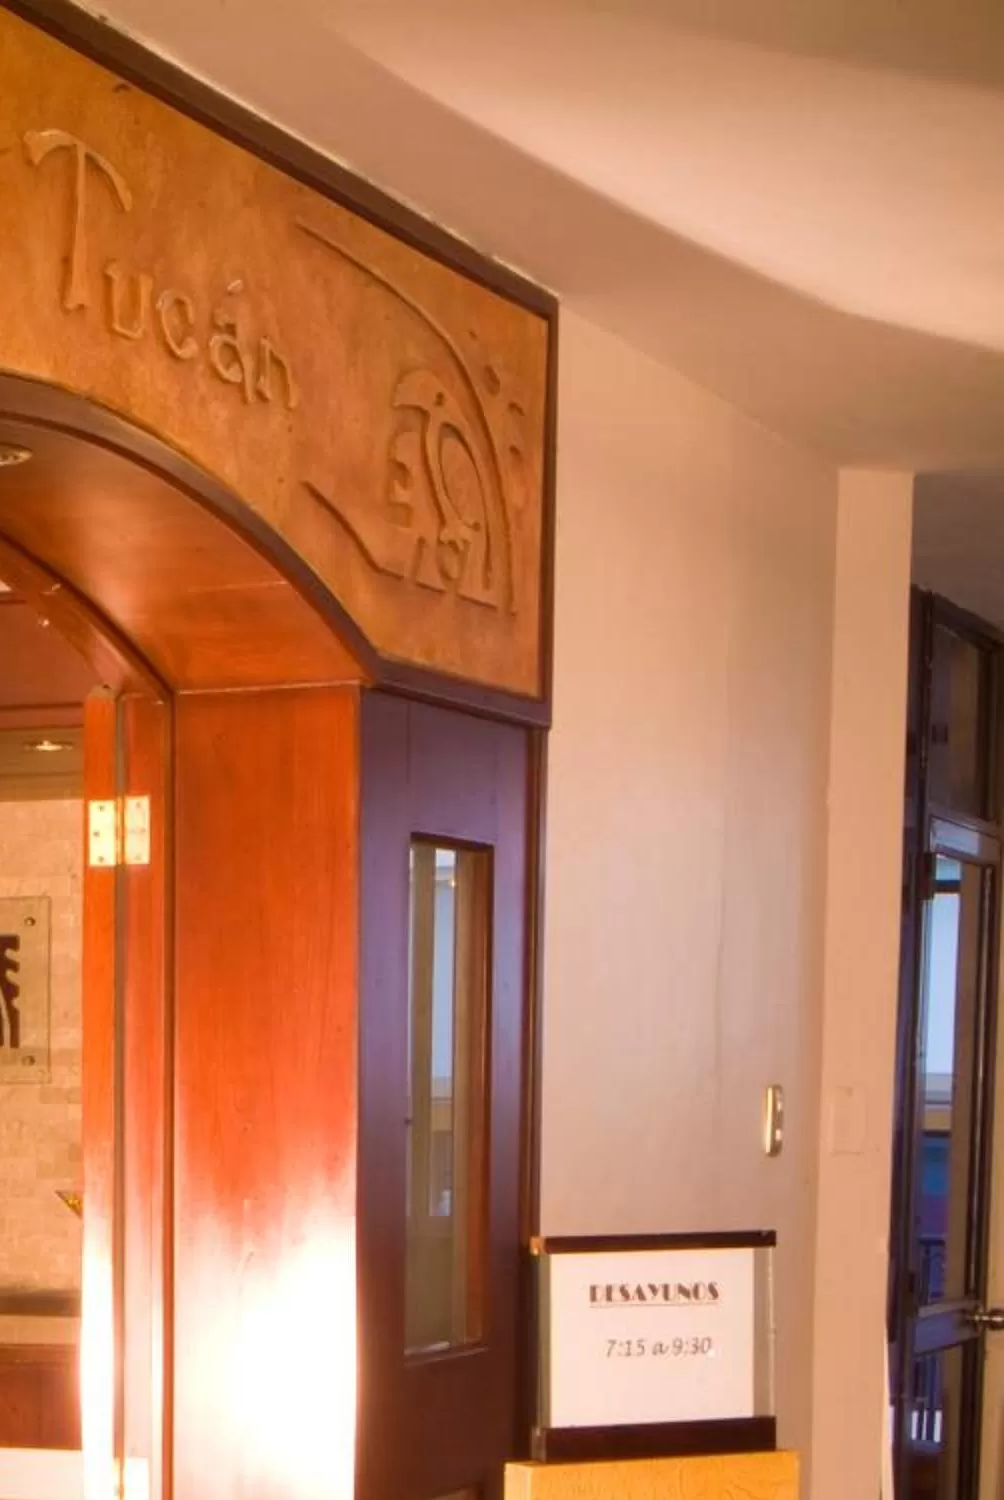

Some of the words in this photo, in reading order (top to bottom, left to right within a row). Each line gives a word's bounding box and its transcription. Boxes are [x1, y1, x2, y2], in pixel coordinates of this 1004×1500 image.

[22, 127, 298, 412] Tucán
[589, 1281, 720, 1304] DESAYUNOS
[605, 1338, 646, 1358] 7:15
[652, 1340, 669, 1356] a
[671, 1336, 713, 1356] 9:30
